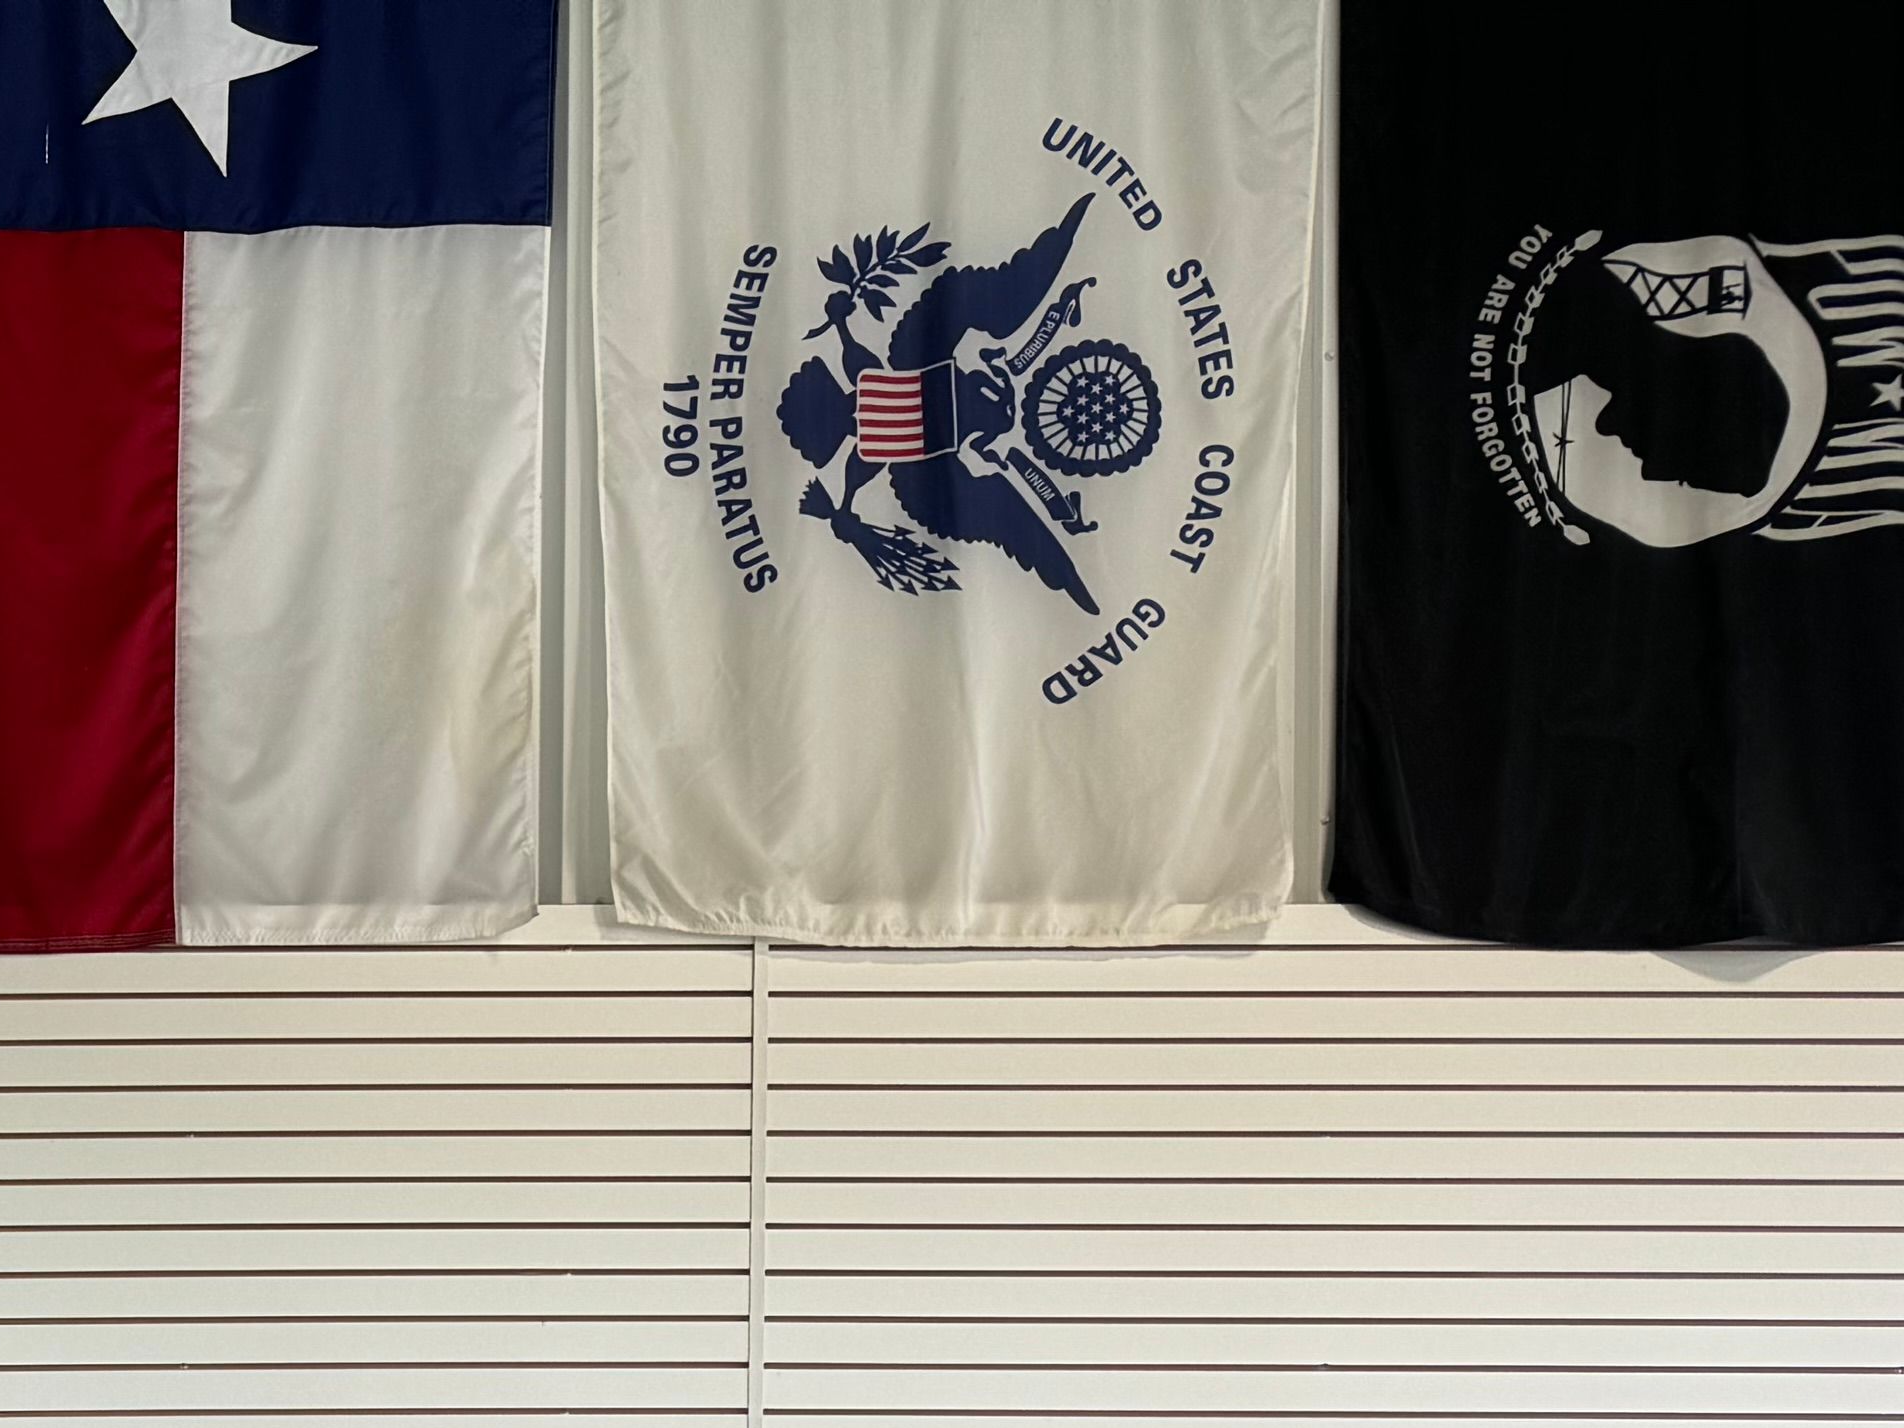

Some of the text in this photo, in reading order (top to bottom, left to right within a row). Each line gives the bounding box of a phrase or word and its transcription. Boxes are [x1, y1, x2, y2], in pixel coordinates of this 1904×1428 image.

[662, 373, 700, 477] 1790
[708, 244, 779, 594] SEMPER PARATUS
[1014, 310, 1060, 369] E PLURIBUS
[1041, 116, 1235, 705] UNITED STATES COAST GUARD
[1469, 223, 1553, 528] YOU ARE NOT FORGOTTEN
[1024, 467, 1055, 502] UNUM
